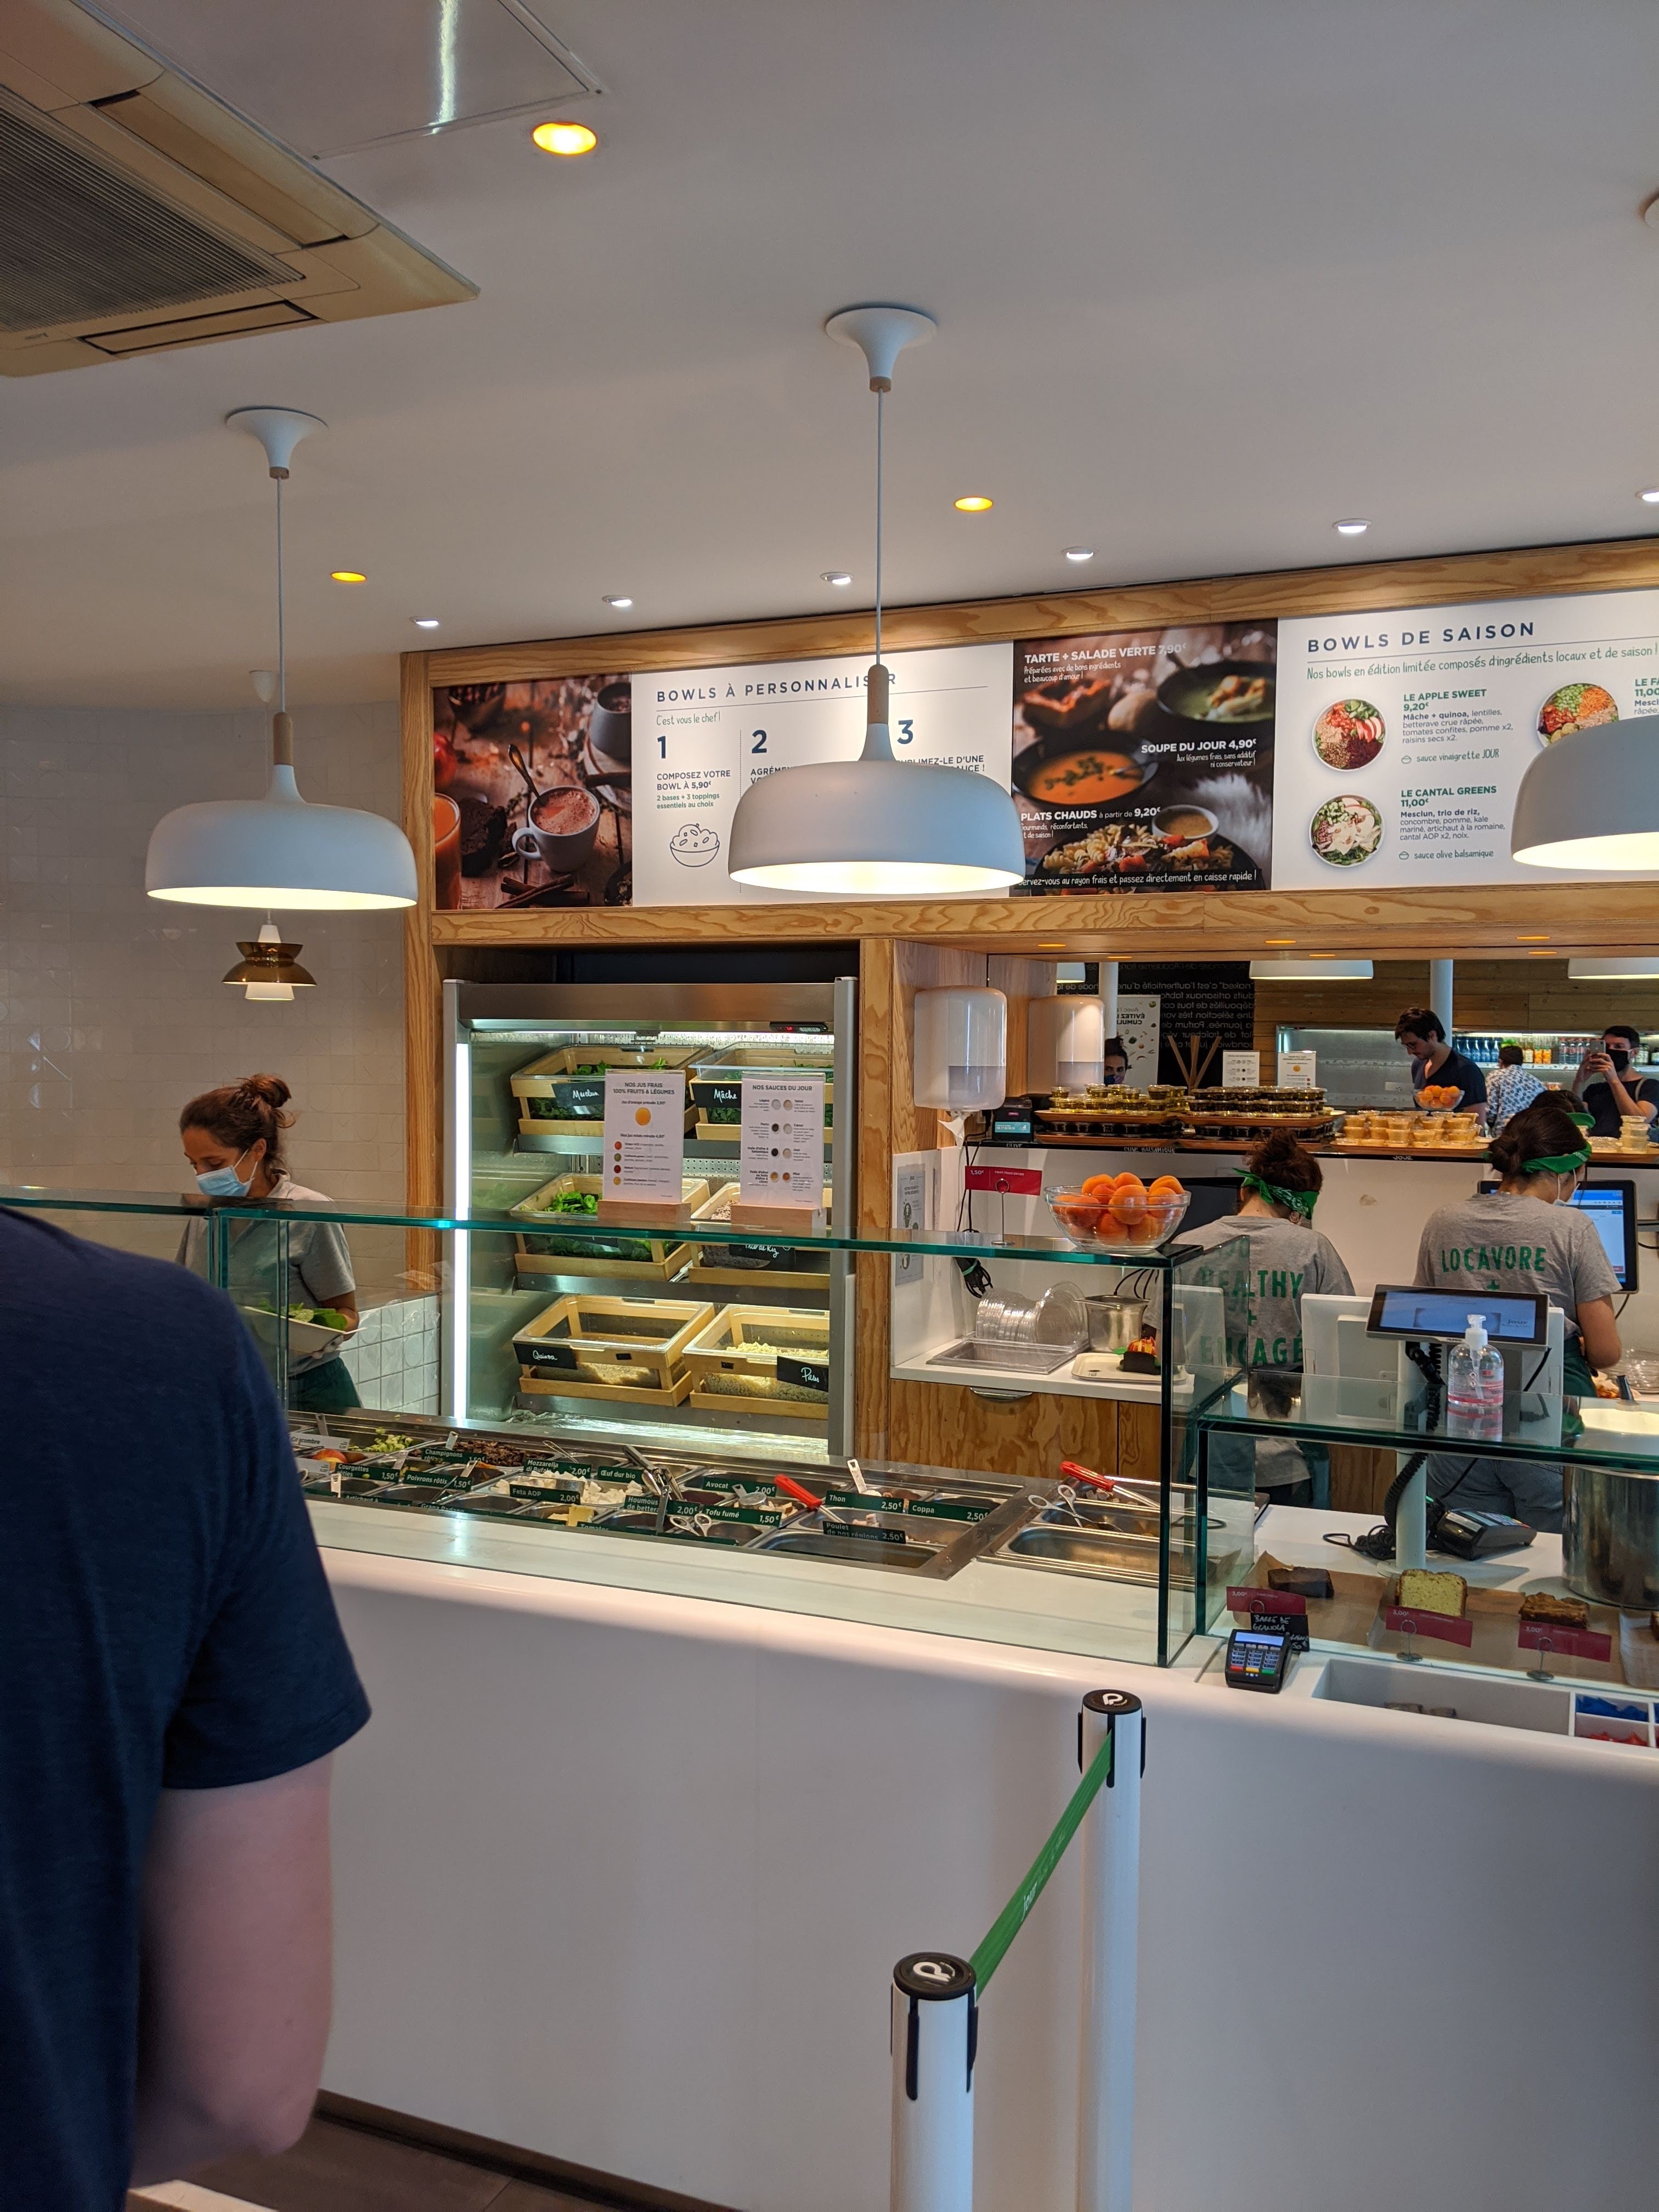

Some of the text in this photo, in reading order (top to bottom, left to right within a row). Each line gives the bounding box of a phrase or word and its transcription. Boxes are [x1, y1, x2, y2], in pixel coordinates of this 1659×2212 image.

[1308, 622, 1533, 652] BOWLS DE SAISON
[1025, 646, 1156, 664] TARTE SALADE VERTE
[1024, 665, 1052, 675] Préparées
[1075, 663, 1088, 671] bons
[1088, 661, 1121, 672] ingrédients
[1307, 647, 1652, 679] Nos bowls en édition limitée composés d'ingrédients locaux et de saison
[1032, 672, 1058, 682] beaucoup
[1635, 678, 1647, 687] LE
[657, 673, 896, 702] BOWLS À PERSONNALISR
[1418, 691, 1449, 701] APPLE
[1452, 689, 1487, 698] SWEET
[1403, 702, 1429, 712] 9,20€
[657, 715, 674, 726] C'est
[1438, 712, 1469, 720] quinoa,
[897, 720, 913, 744] 3
[1470, 725, 1500, 733] pomme
[657, 736, 666, 759] 1
[752, 730, 767, 754] 2
[1141, 738, 1257, 753] SOUPE DU JOUR 4,90€
[956, 755, 984, 763] D'UNE
[1186, 753, 1209, 763] légumes
[1439, 751, 1480, 761] vinaigrette
[1482, 748, 1499, 759] JOUR
[657, 770, 731, 781] COMPOSEZ VOTRE
[657, 781, 712, 791] BOWL 5,90€
[1415, 788, 1455, 797] CANTAL
[1457, 786, 1497, 795] GREENS
[692, 793, 720, 801] toppings
[1401, 798, 1429, 808] 11,00€
[1021, 812, 1052, 821] PLATS
[1054, 810, 1097, 820] CHAUDS
[1134, 806, 1161, 817] 9,20€
[1401, 810, 1435, 819] Mesclun,
[1436, 850, 1453, 858] olive
[1454, 849, 1494, 859] balsamique
[1071, 878, 1090, 886] rayon
[1092, 874, 1107, 884] frais
[1109, 874, 1118, 884] et
[1120, 876, 1144, 885] passez
[1146, 872, 1192, 883] directement
[1229, 871, 1252, 882] rapide
[714, 1088, 737, 1103] Mâche
[1441, 1246, 1547, 1272] LOCAVORE
[801, 1367, 819, 1383] Pâtes
[425, 1449, 463, 1458] Champignons
[338, 1464, 369, 1472] Courgettes
[527, 1460, 558, 1468] Mozzarella
[381, 1472, 398, 1480] 1,50€
[407, 1474, 432, 1483] Poivrons
[453, 1480, 471, 1488] 1,50€
[560, 1494, 579, 1502] 2,00€
[628, 1497, 658, 1505] Houmous
[829, 1494, 901, 1510] Thon 2,50€
[677, 1506, 698, 1515] 2,00€
[912, 1505, 935, 1514] Coppa
[722, 1510, 740, 1518] fumé
[759, 1515, 780, 1523] 1,50€
[826, 1522, 849, 1530] Poulet
